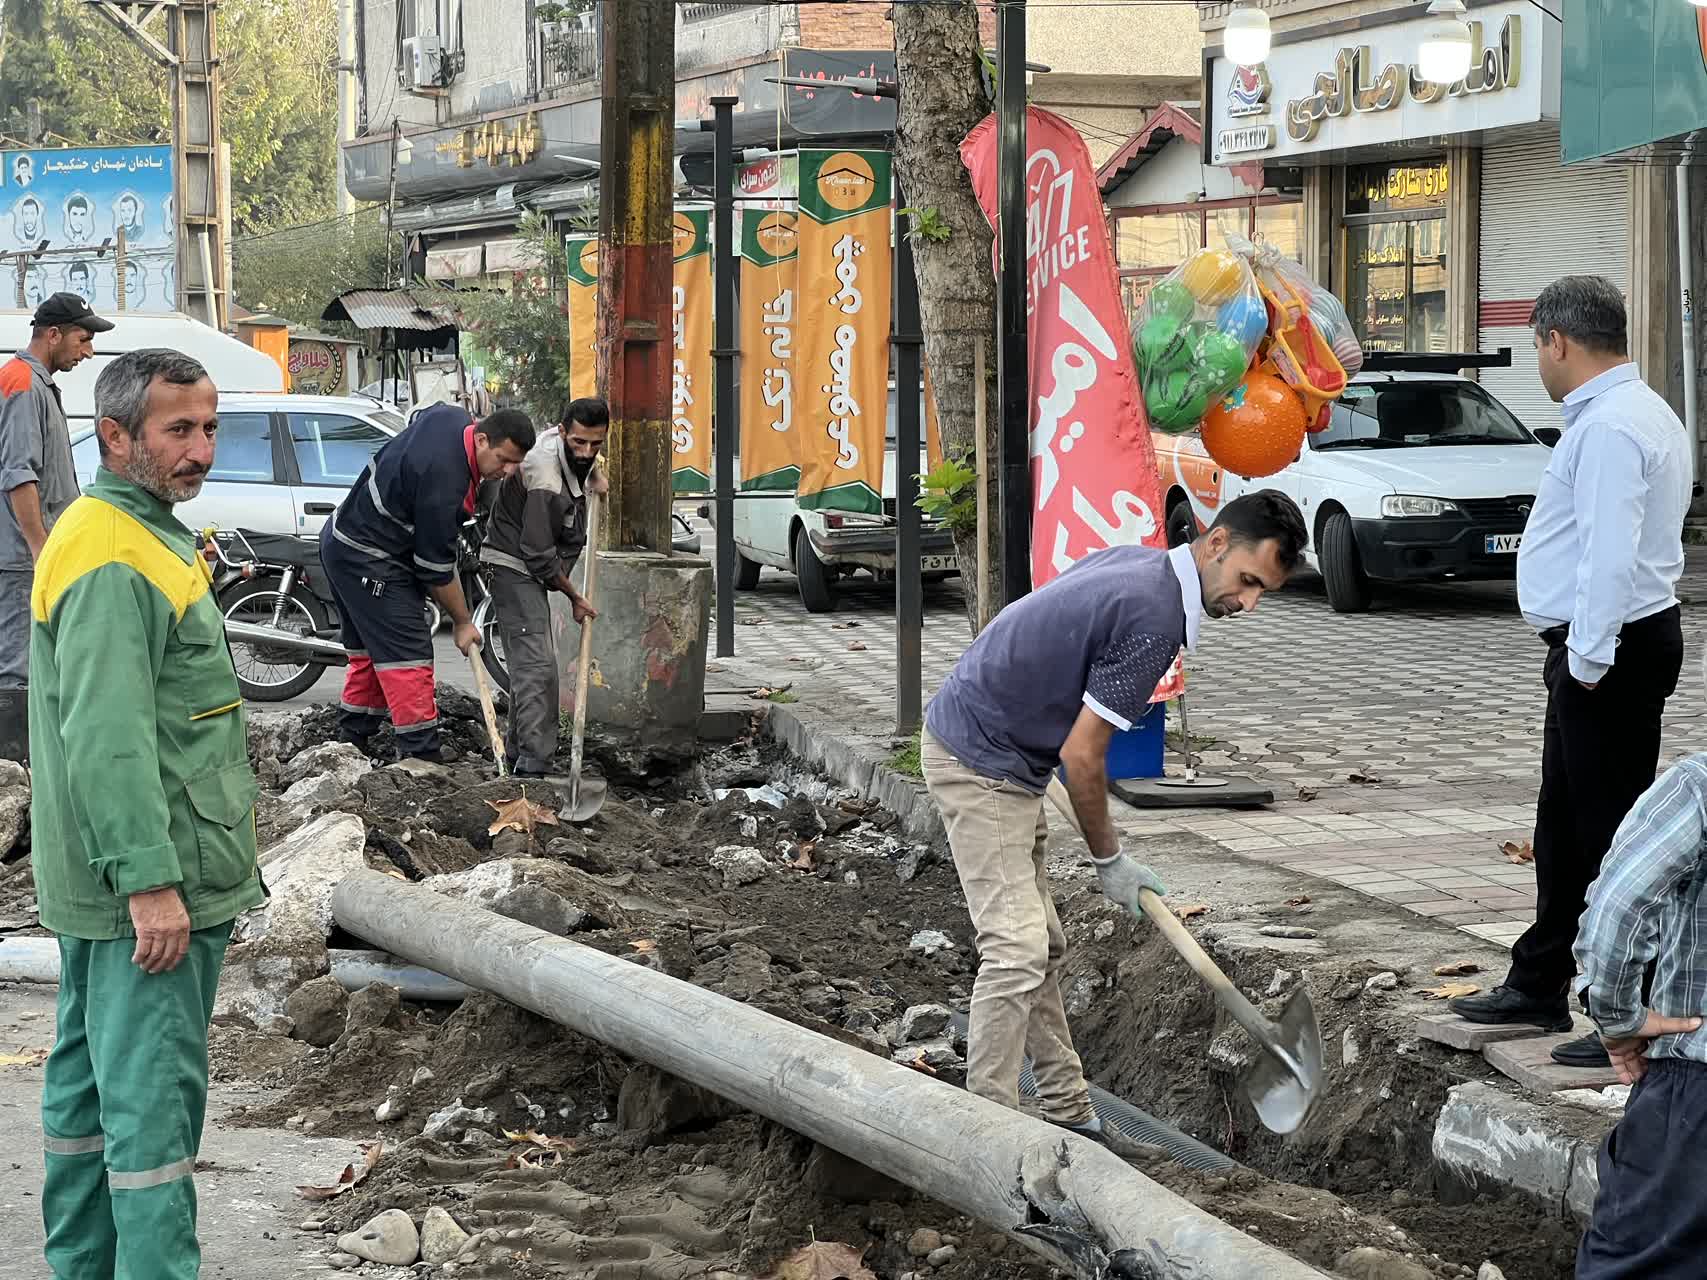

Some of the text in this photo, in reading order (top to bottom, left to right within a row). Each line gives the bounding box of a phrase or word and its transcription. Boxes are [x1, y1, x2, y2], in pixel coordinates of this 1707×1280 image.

[1286, 15, 1520, 142] امل صالحی
[91, 156, 127, 174] شهدای
[1027, 168, 1074, 262] 4/7
[828, 234, 866, 315] چمن
[821, 324, 862, 471] مصنوعی
